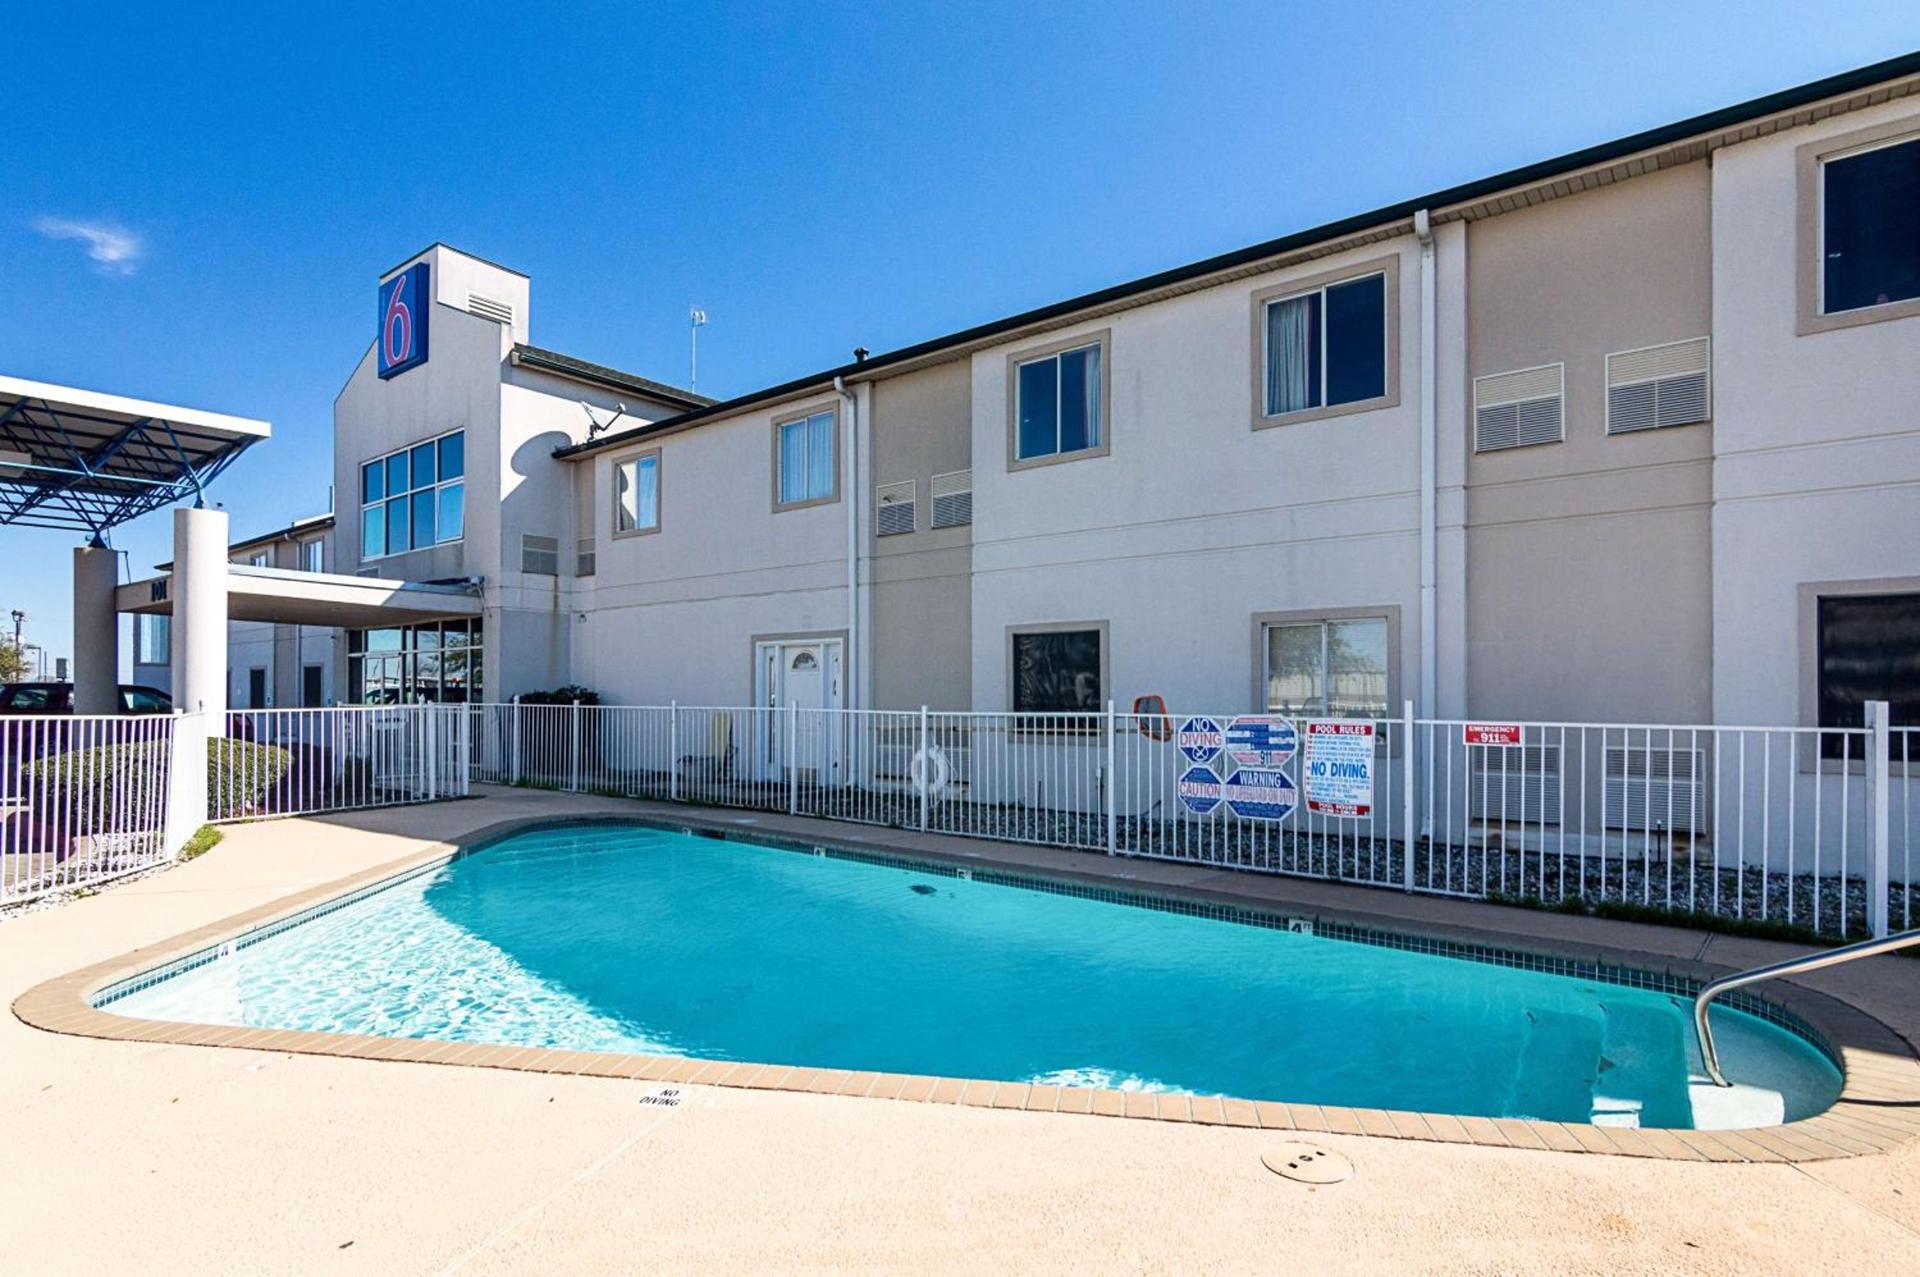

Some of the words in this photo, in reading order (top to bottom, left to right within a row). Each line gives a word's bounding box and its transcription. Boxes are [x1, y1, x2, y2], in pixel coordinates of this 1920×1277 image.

[384, 275, 411, 367] 6
[1192, 719, 1209, 732] NO
[1315, 725, 1335, 733] POOL
[1339, 726, 1366, 735] RULES
[1180, 732, 1222, 746] DIVING
[1480, 733, 1500, 743] 911
[1260, 751, 1272, 765] 911
[1311, 762, 1326, 776] NO
[1239, 771, 1281, 787] WARNING
[1179, 783, 1221, 798] CAUTION
[1290, 922, 1303, 934] 4
[660, 1089, 679, 1097] NO
[639, 1096, 680, 1106] DIVING
